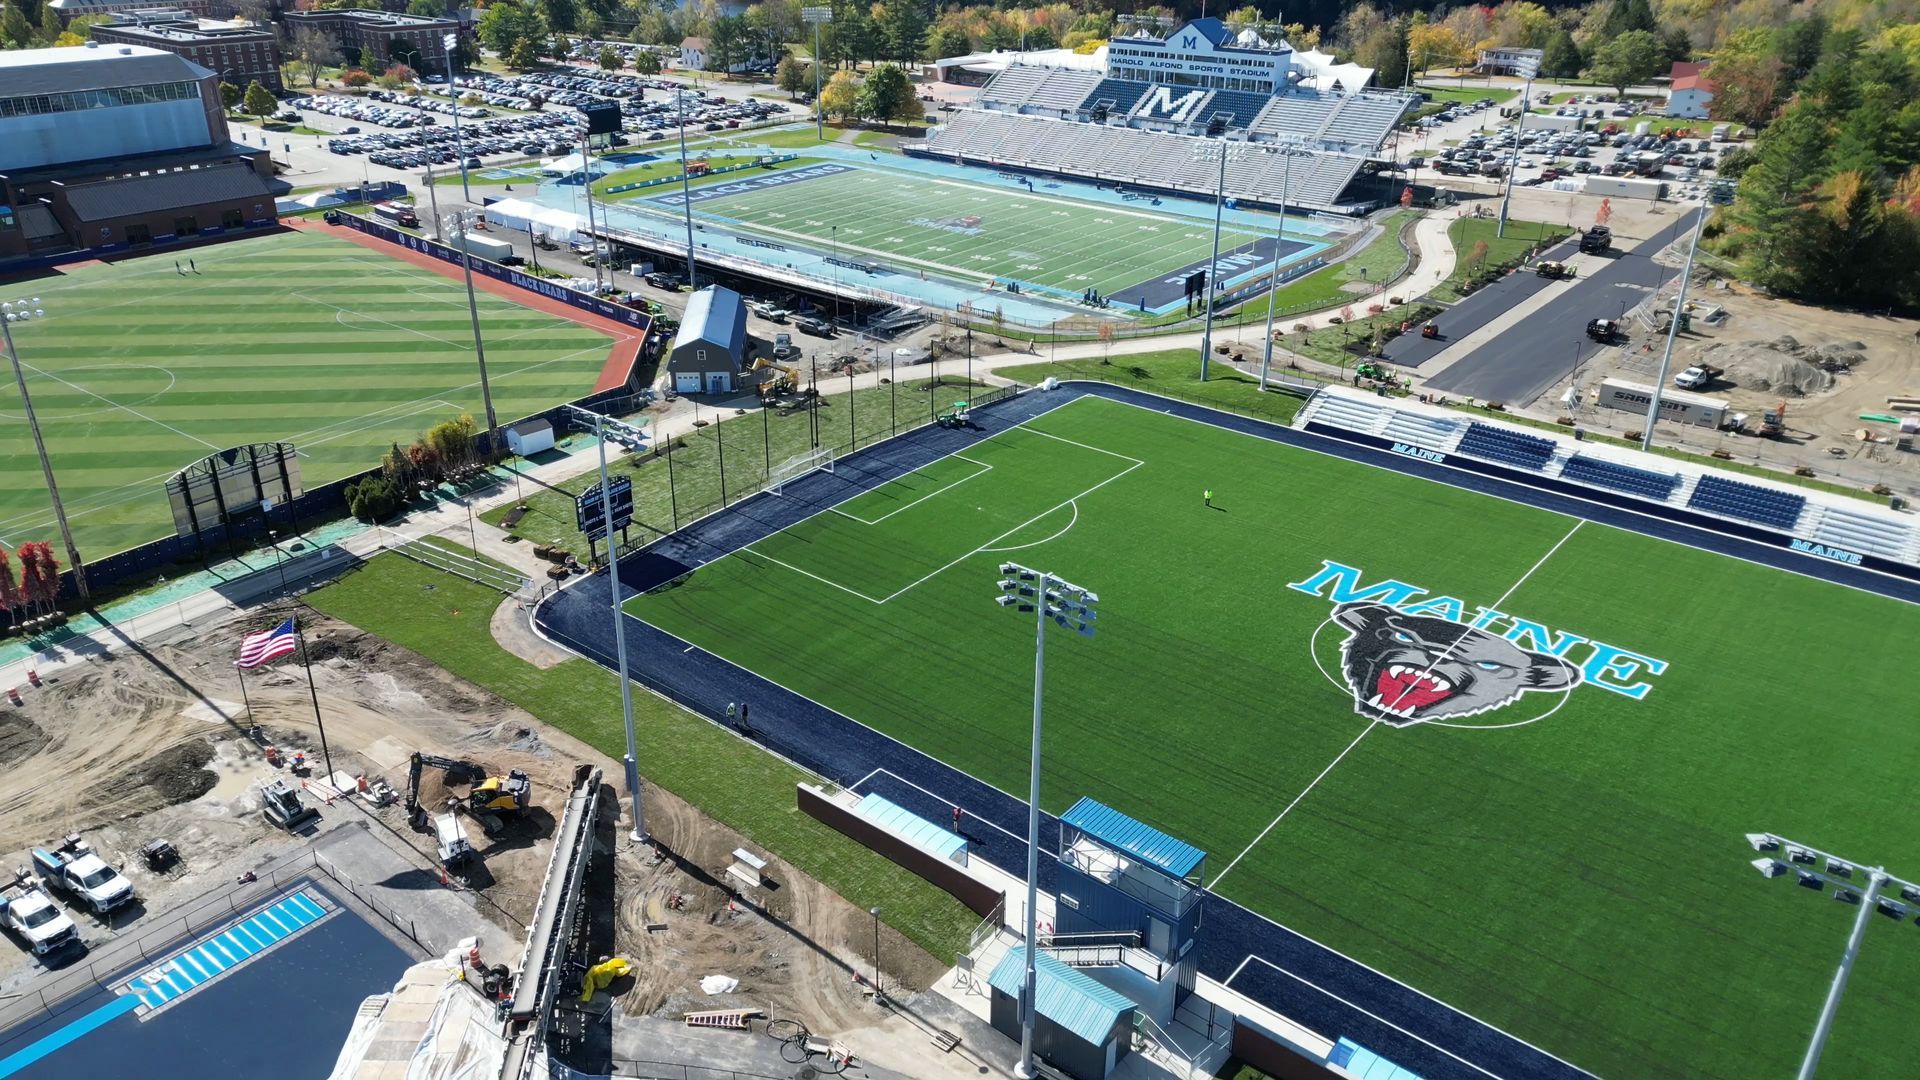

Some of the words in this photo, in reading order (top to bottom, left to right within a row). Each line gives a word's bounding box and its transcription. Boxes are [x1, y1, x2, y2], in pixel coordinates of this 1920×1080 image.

[1183, 35, 1196, 50] M
[1111, 57, 1144, 66] HAROLD
[1150, 60, 1183, 70] ALFOND
[1189, 64, 1224, 74] SPORTS
[1229, 68, 1270, 78] STADIUM
[1136, 86, 1206, 122] M
[660, 178, 760, 205] BLACK
[757, 164, 845, 186] BEARS
[510, 271, 539, 291] BLACK
[538, 281, 568, 301] BEARS
[1613, 391, 1691, 411] SARENT
[1390, 442, 1446, 463] MAINE
[1789, 538, 1863, 565] MAINE
[1286, 559, 1670, 701] MAINE
